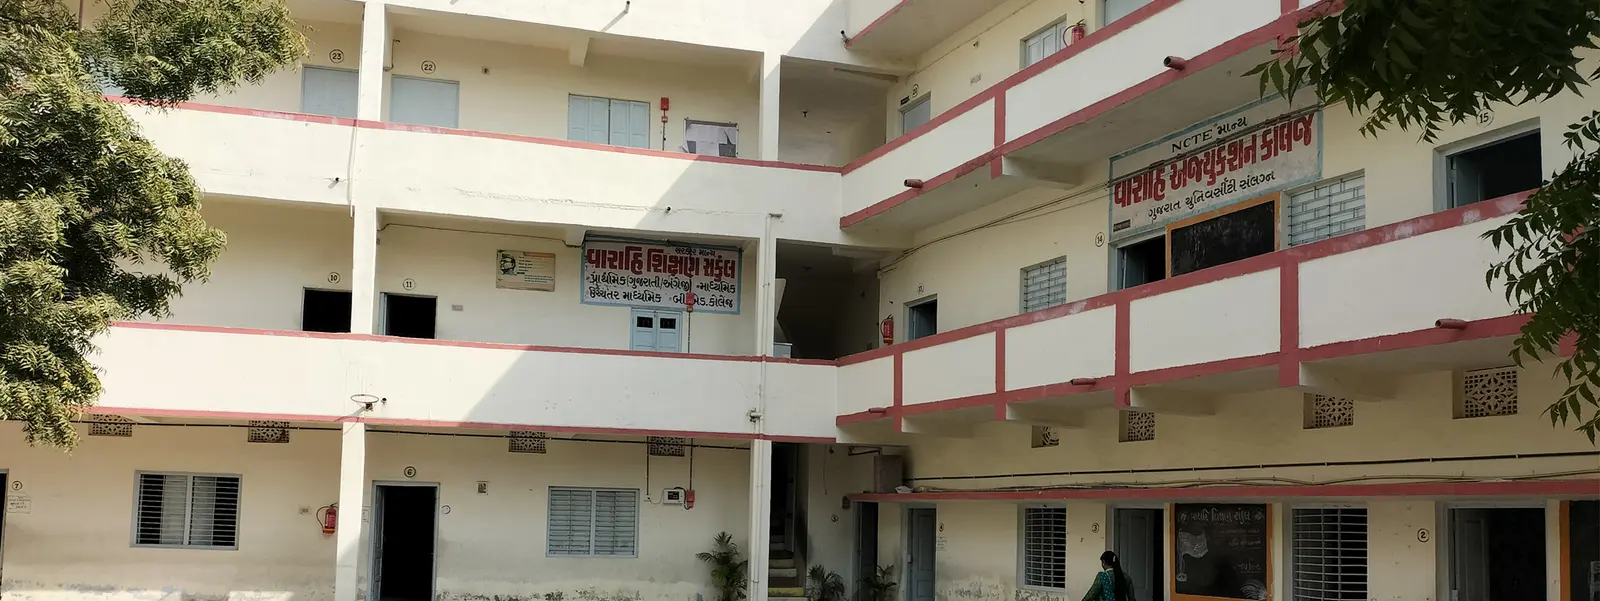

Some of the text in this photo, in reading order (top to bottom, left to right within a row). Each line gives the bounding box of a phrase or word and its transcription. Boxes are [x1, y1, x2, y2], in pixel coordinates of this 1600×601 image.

[1171, 116, 1248, 153] NCTE માન્ય
[1148, 201, 1181, 220] ગુજરાત
[1239, 171, 1276, 190] સંલગ્ન
[587, 246, 643, 275] વારાહિ
[646, 248, 700, 279] શિક્ષણ
[623, 289, 662, 303] માધ્યમિક
